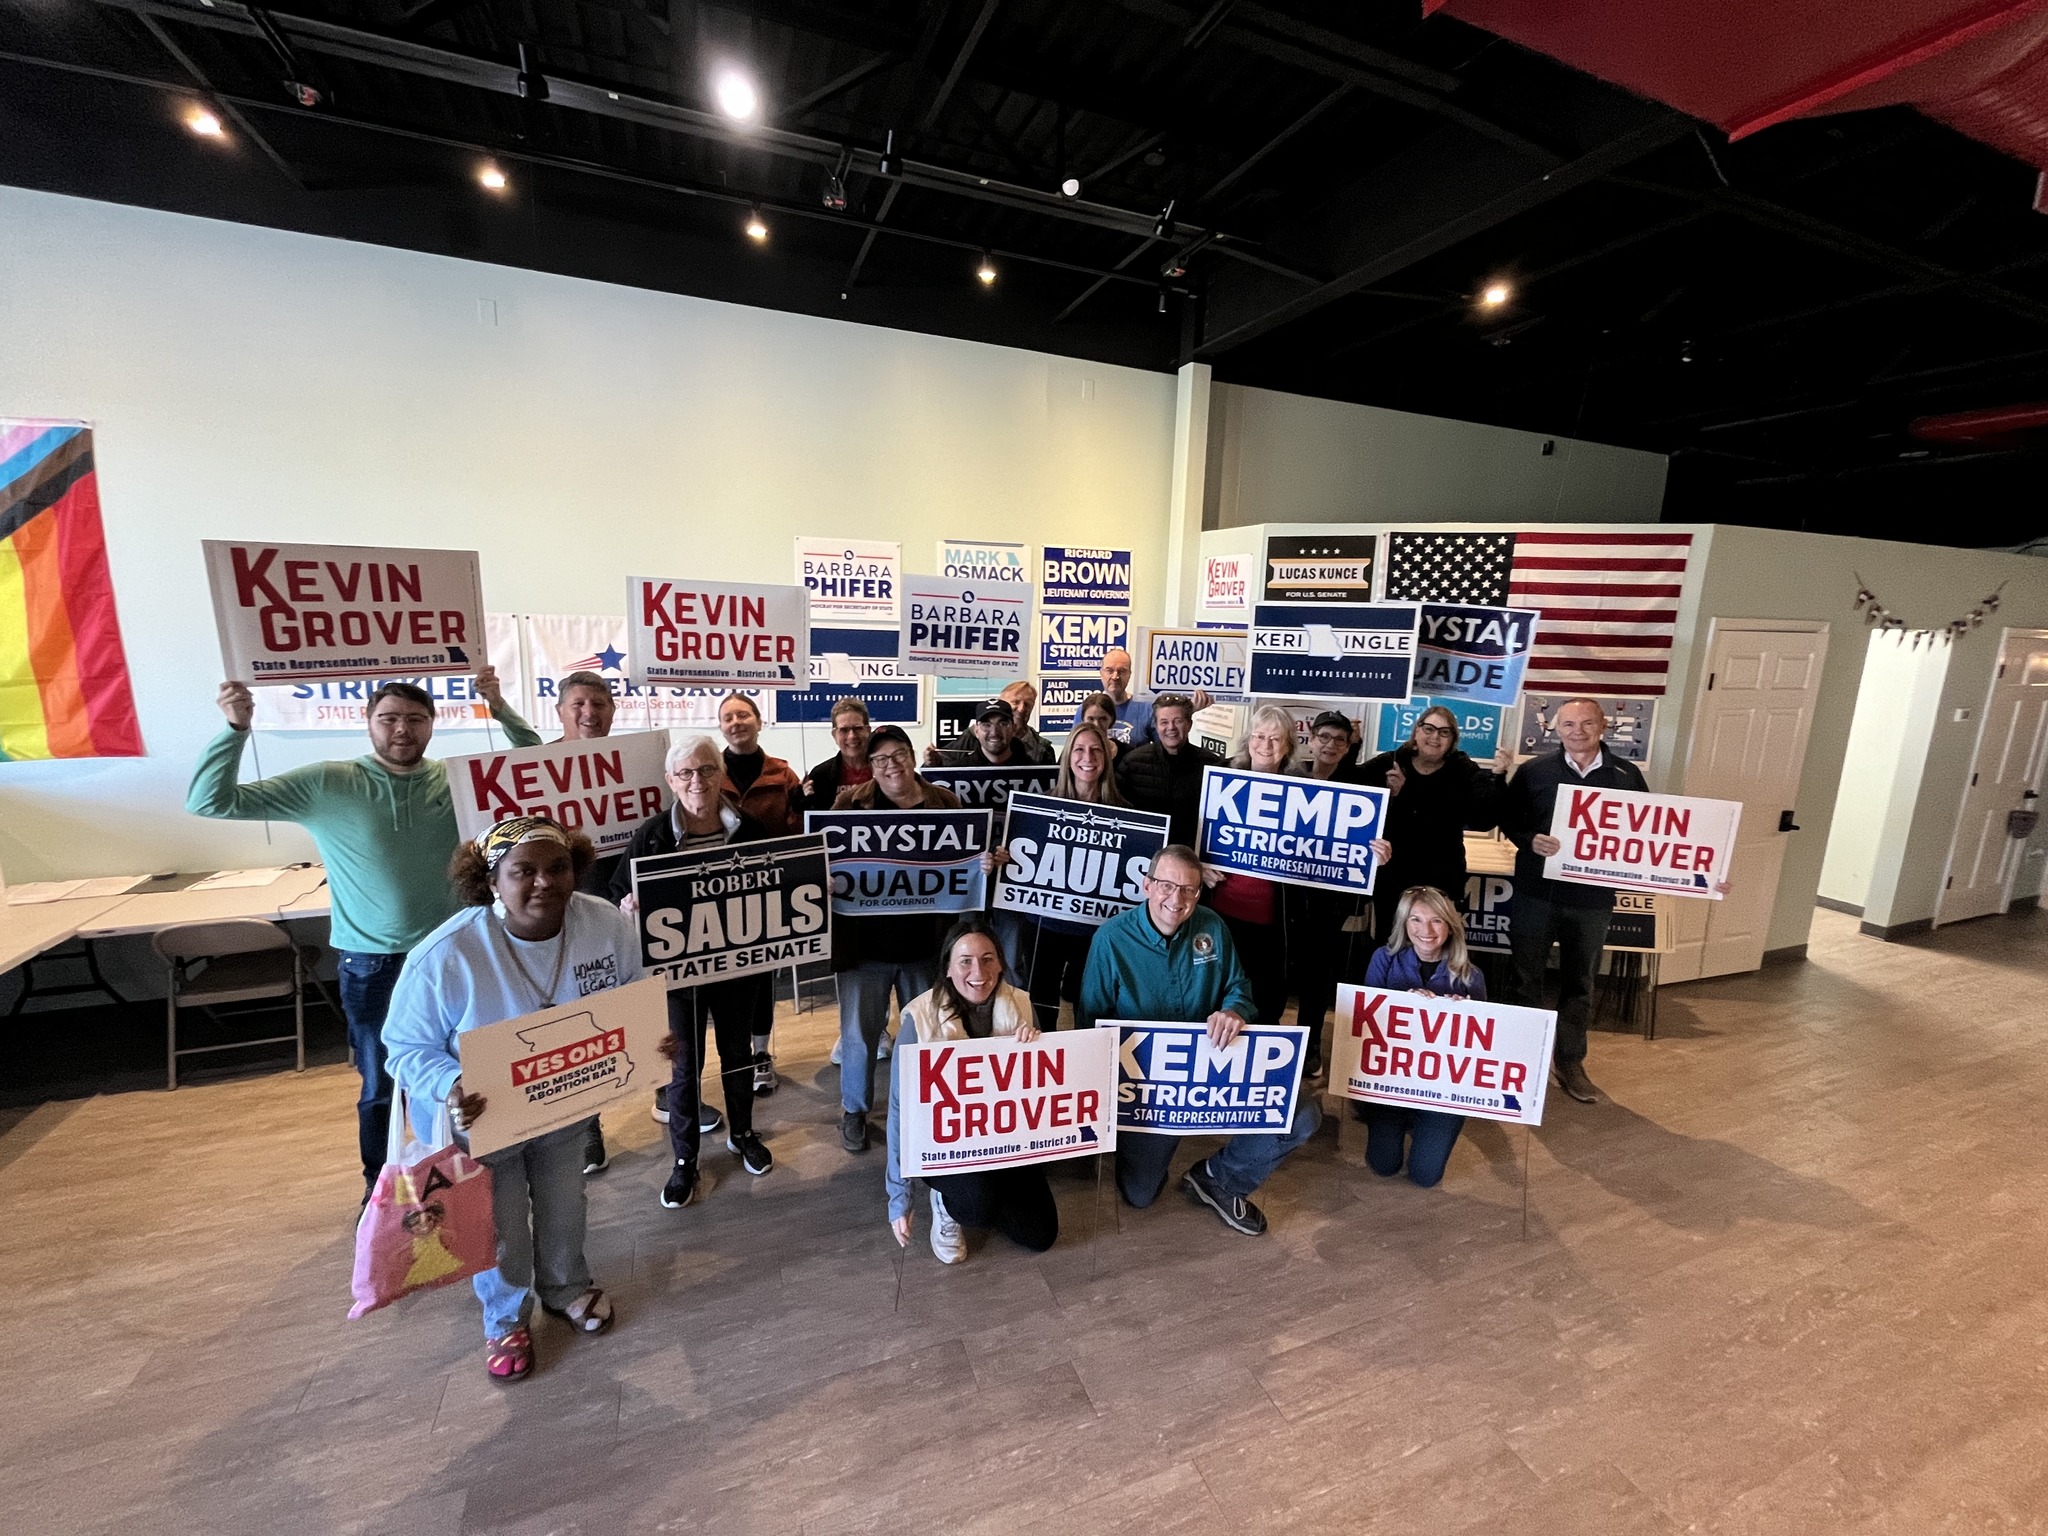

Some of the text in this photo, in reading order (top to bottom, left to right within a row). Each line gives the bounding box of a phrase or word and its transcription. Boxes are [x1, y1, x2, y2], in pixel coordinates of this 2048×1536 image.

[945, 549, 1000, 565] MARK
[1064, 549, 1112, 559] RICHARD
[230, 547, 422, 608] KEVIN
[804, 561, 892, 578] BARBARA
[945, 565, 1024, 582] OSMACK
[1044, 560, 1129, 585] BROWN
[1208, 559, 1238, 581] KEVIN
[1279, 568, 1358, 579] LUCAS KUNCE
[805, 577, 892, 599] PHIFER
[1043, 588, 1129, 599] LIEUTENANT GOVERNOR
[1208, 580, 1245, 597] GROVER
[643, 582, 765, 628] KEVIN
[911, 604, 1020, 626] BARBARA
[259, 605, 466, 652] GROVER
[910, 623, 1019, 652] PHIFER
[1042, 615, 1125, 644] KEMP
[1255, 633, 1410, 650] KERI INGLE
[1422, 614, 1523, 648] YSTAL
[655, 625, 794, 663] GROVER
[1156, 640, 1217, 662] AARON
[252, 660, 286, 671] State
[290, 657, 380, 669] Representative
[391, 655, 429, 665] District
[432, 654, 444, 664] 30
[647, 666, 667, 675] State
[670, 667, 729, 677] Representative
[737, 670, 765, 678] District
[958, 658, 990, 666] SECRETARY
[1155, 664, 1245, 687] CROSSLEY
[1266, 668, 1392, 680] STATE REPRESENTATIVE
[1202, 738, 1224, 754] VOTE
[468, 750, 624, 813] KEVIN
[1205, 775, 1376, 840] KEMP
[1568, 789, 1691, 837] KEVIN
[600, 831, 633, 844] District
[819, 824, 980, 854] CRYSTAL
[1047, 823, 1127, 849] ROBERT
[1217, 825, 1368, 866] STRICKLER
[1231, 850, 1259, 866] STATE
[1260, 855, 1344, 880] REPRESENTATIVE
[1574, 829, 1715, 873] GROVER
[691, 867, 784, 899] ROBERT
[1005, 837, 1152, 902] SAULS
[1561, 863, 1582, 873] State
[1584, 866, 1643, 880] Representative
[830, 868, 968, 902] QUADE
[1004, 887, 1064, 911] STATE
[859, 897, 936, 907] FOR GOVERNOR
[645, 884, 823, 960] SAULS
[735, 937, 822, 968] SENATE
[573, 953, 615, 982] HOMAGE
[1351, 991, 1495, 1052] KEVIN
[517, 1033, 620, 1080] YES ON 3
[1119, 1030, 1295, 1084] KEMP
[1360, 1038, 1527, 1093] GROVER
[525, 1056, 617, 1094] END MISSOURI'S
[528, 1065, 616, 1103] ABORTION BAN
[919, 1047, 1064, 1104] KEVIN
[1118, 1082, 1287, 1108] STRICKLER
[1348, 1077, 1371, 1090] State
[1373, 1082, 1442, 1100] Representative
[1451, 1093, 1485, 1106] District
[1487, 1099, 1500, 1108] 30
[933, 1089, 1098, 1144] GROVER
[1133, 1108, 1261, 1124] STATE REPRESENTATIVE
[921, 1151, 947, 1161] State
[949, 1143, 1021, 1160] Representative
[1030, 1137, 1064, 1150] District
[1065, 1134, 1077, 1145] 30
